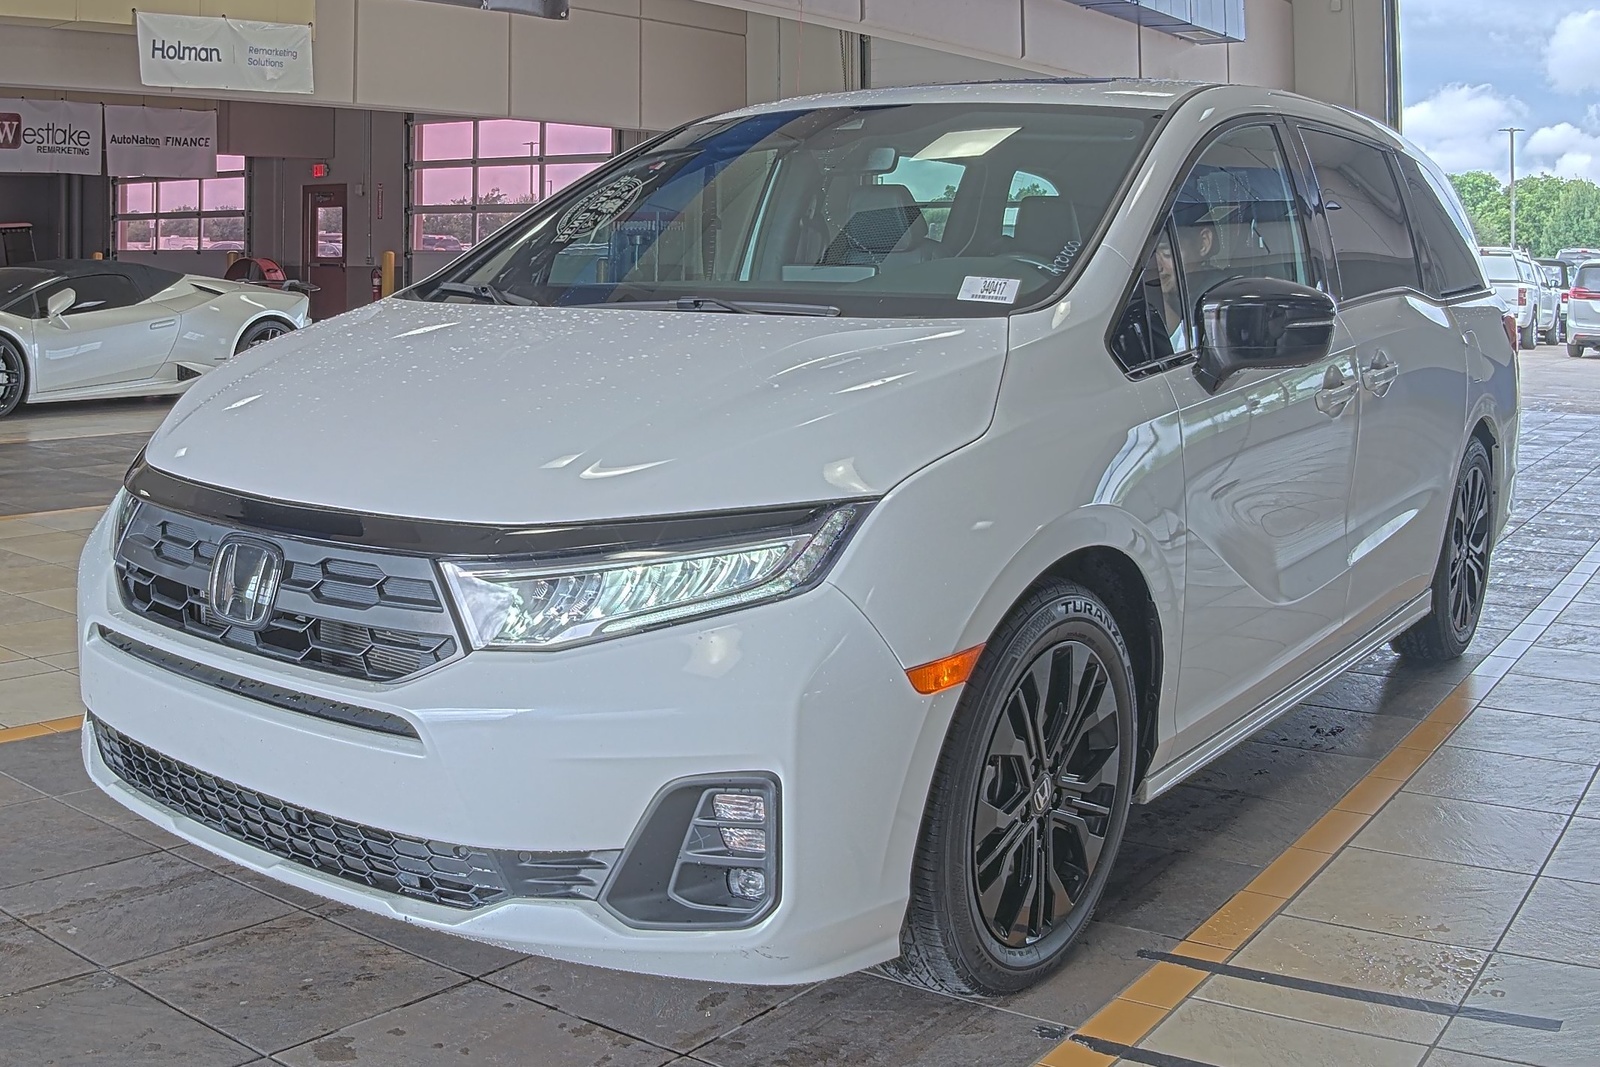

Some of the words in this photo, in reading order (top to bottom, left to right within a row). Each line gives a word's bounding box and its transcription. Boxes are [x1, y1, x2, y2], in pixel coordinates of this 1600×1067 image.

[151, 39, 222, 63] Holman
[248, 46, 298, 60] Remarketing
[247, 58, 284, 68] Solutions
[109, 134, 160, 146] AutoNation
[165, 136, 211, 148] FINANCE
[980, 281, 1008, 295] 340417
